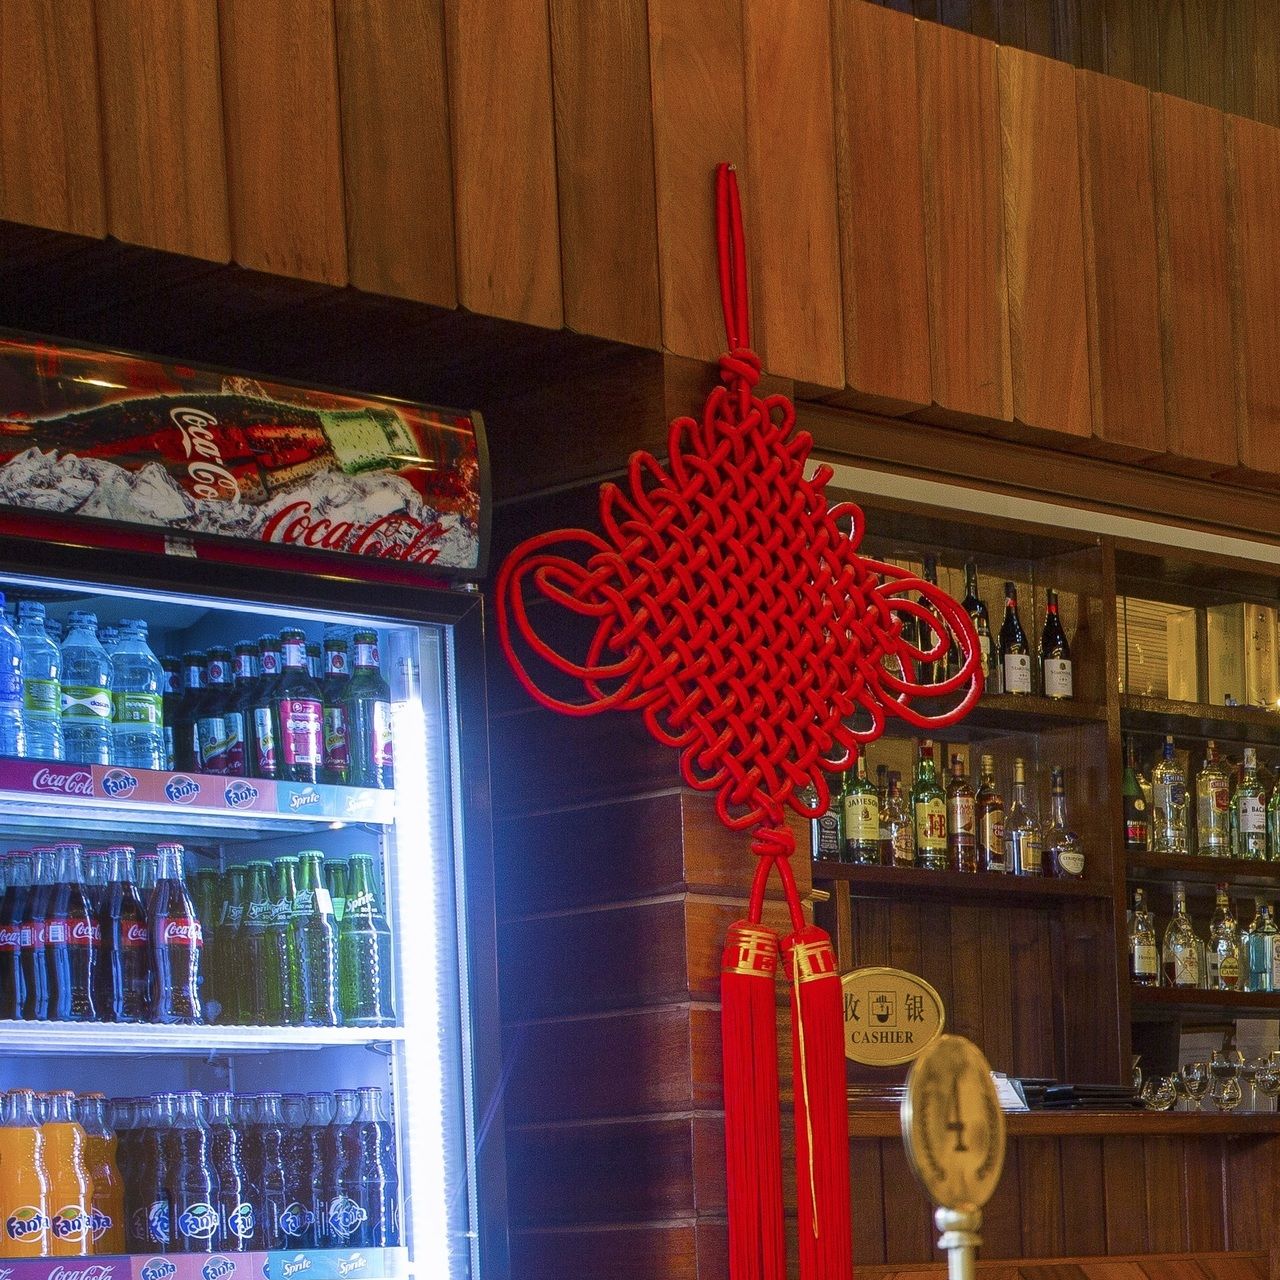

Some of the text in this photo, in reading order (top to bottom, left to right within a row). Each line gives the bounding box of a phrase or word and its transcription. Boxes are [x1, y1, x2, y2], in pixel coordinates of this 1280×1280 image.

[102, 774, 138, 796] Fanta
[165, 778, 200, 802] Fanta
[224, 783, 259, 807] Fanta
[290, 793, 320, 809] Sprite
[847, 798, 878, 808] JAMESO
[346, 891, 375, 912] Sprite
[904, 993, 924, 1022] 银
[851, 1030, 914, 1044] CASHIER
[6, 1215, 50, 1240] Fanta
[51, 1215, 92, 1238] Fanta
[179, 1211, 219, 1238] Fanta
[283, 1258, 312, 1276] Sprite
[340, 1258, 367, 1275] Sprite
